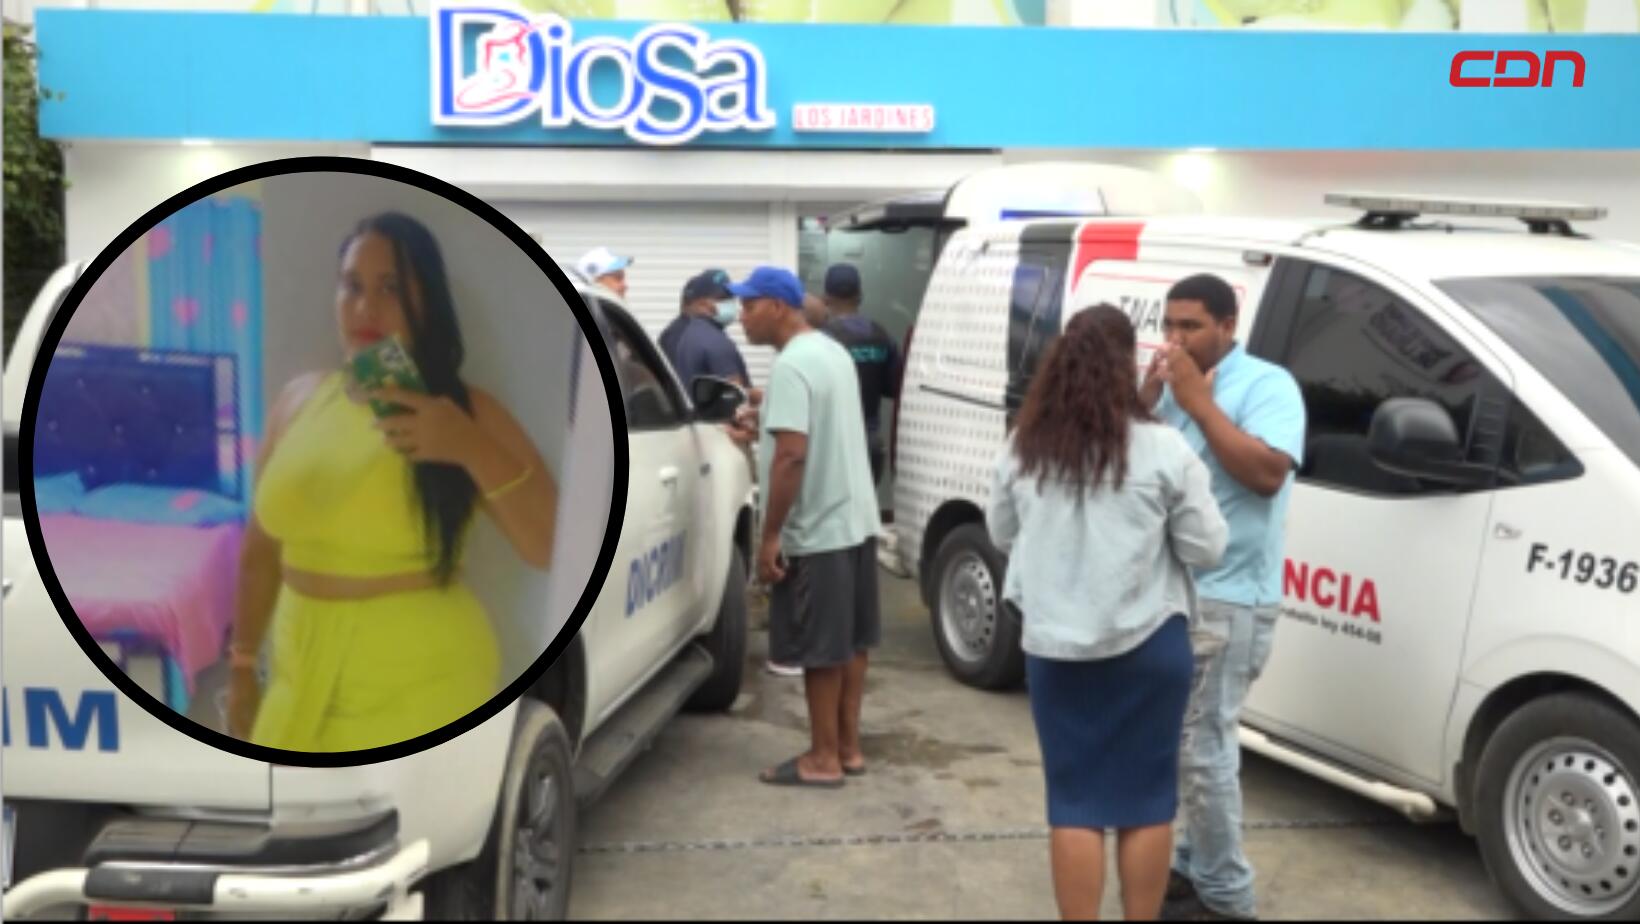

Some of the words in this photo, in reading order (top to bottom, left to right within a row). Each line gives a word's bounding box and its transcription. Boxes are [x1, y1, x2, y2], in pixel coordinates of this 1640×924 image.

[794, 106, 832, 130] LOS
[839, 106, 934, 131] JARDINES
[1283, 557, 1382, 623] NCIA
[1526, 541, 1640, 594] F-1936
